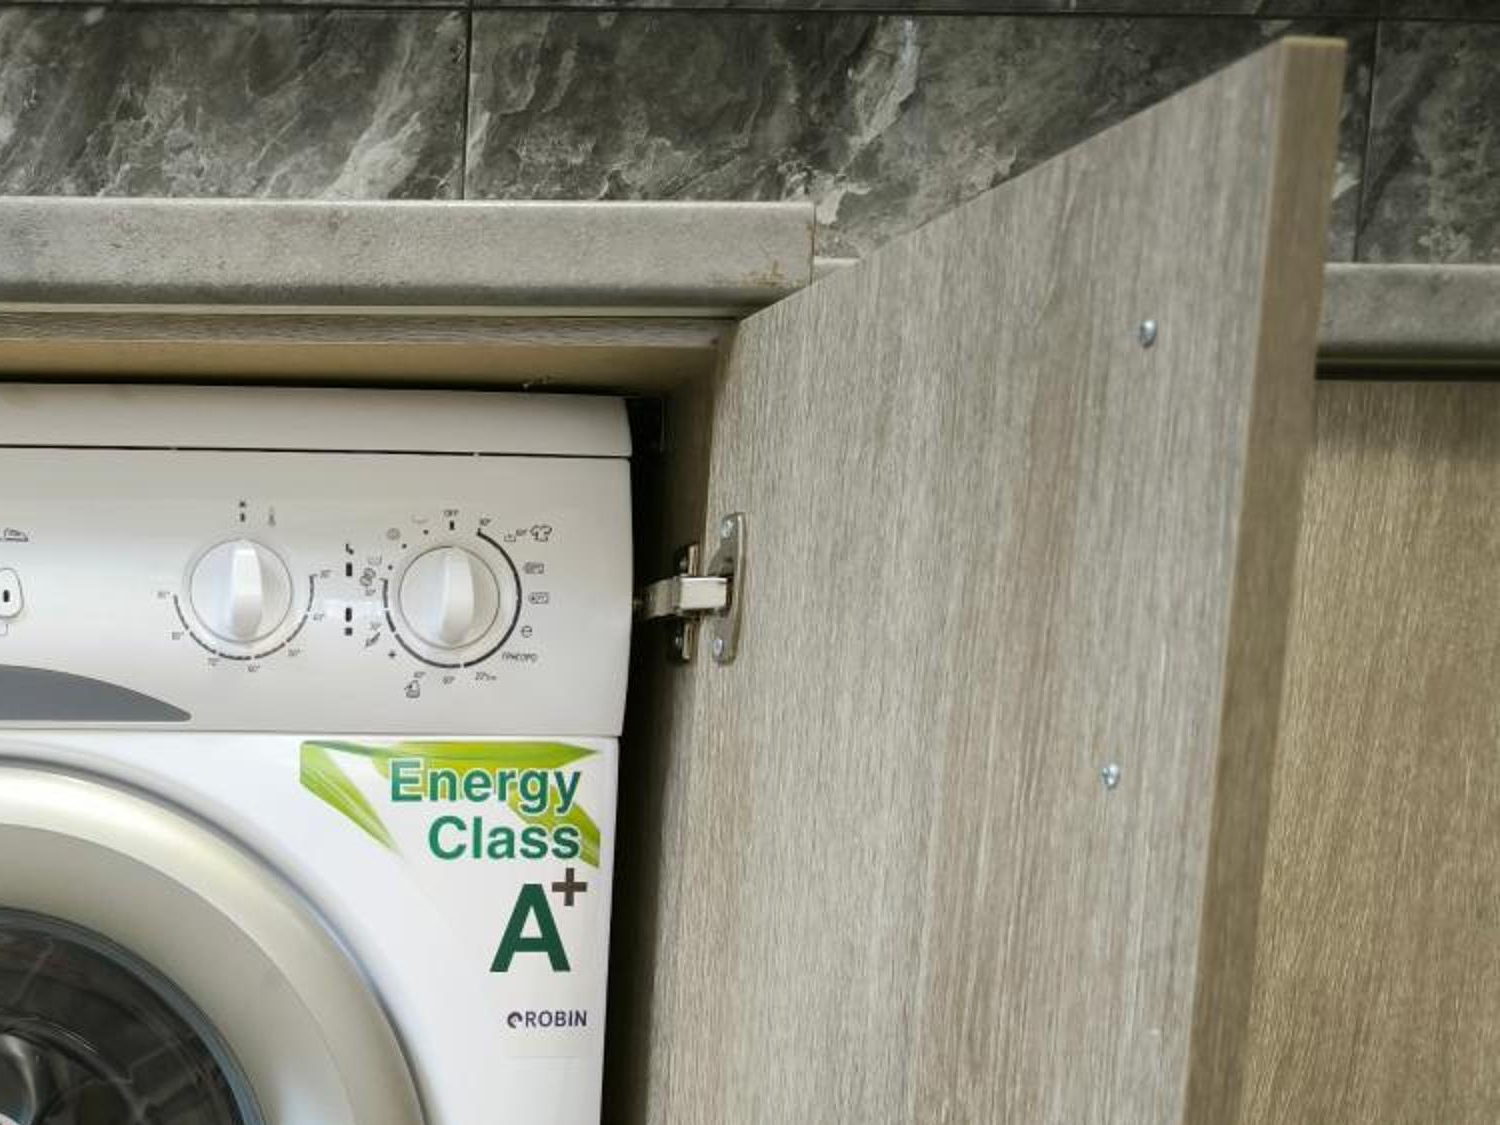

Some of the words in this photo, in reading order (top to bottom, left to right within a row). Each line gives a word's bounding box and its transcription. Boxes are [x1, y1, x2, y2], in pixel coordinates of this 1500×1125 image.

[390, 759, 582, 815] Energy
[428, 815, 582, 861] Class
[524, 1009, 588, 1029] ROBIN
